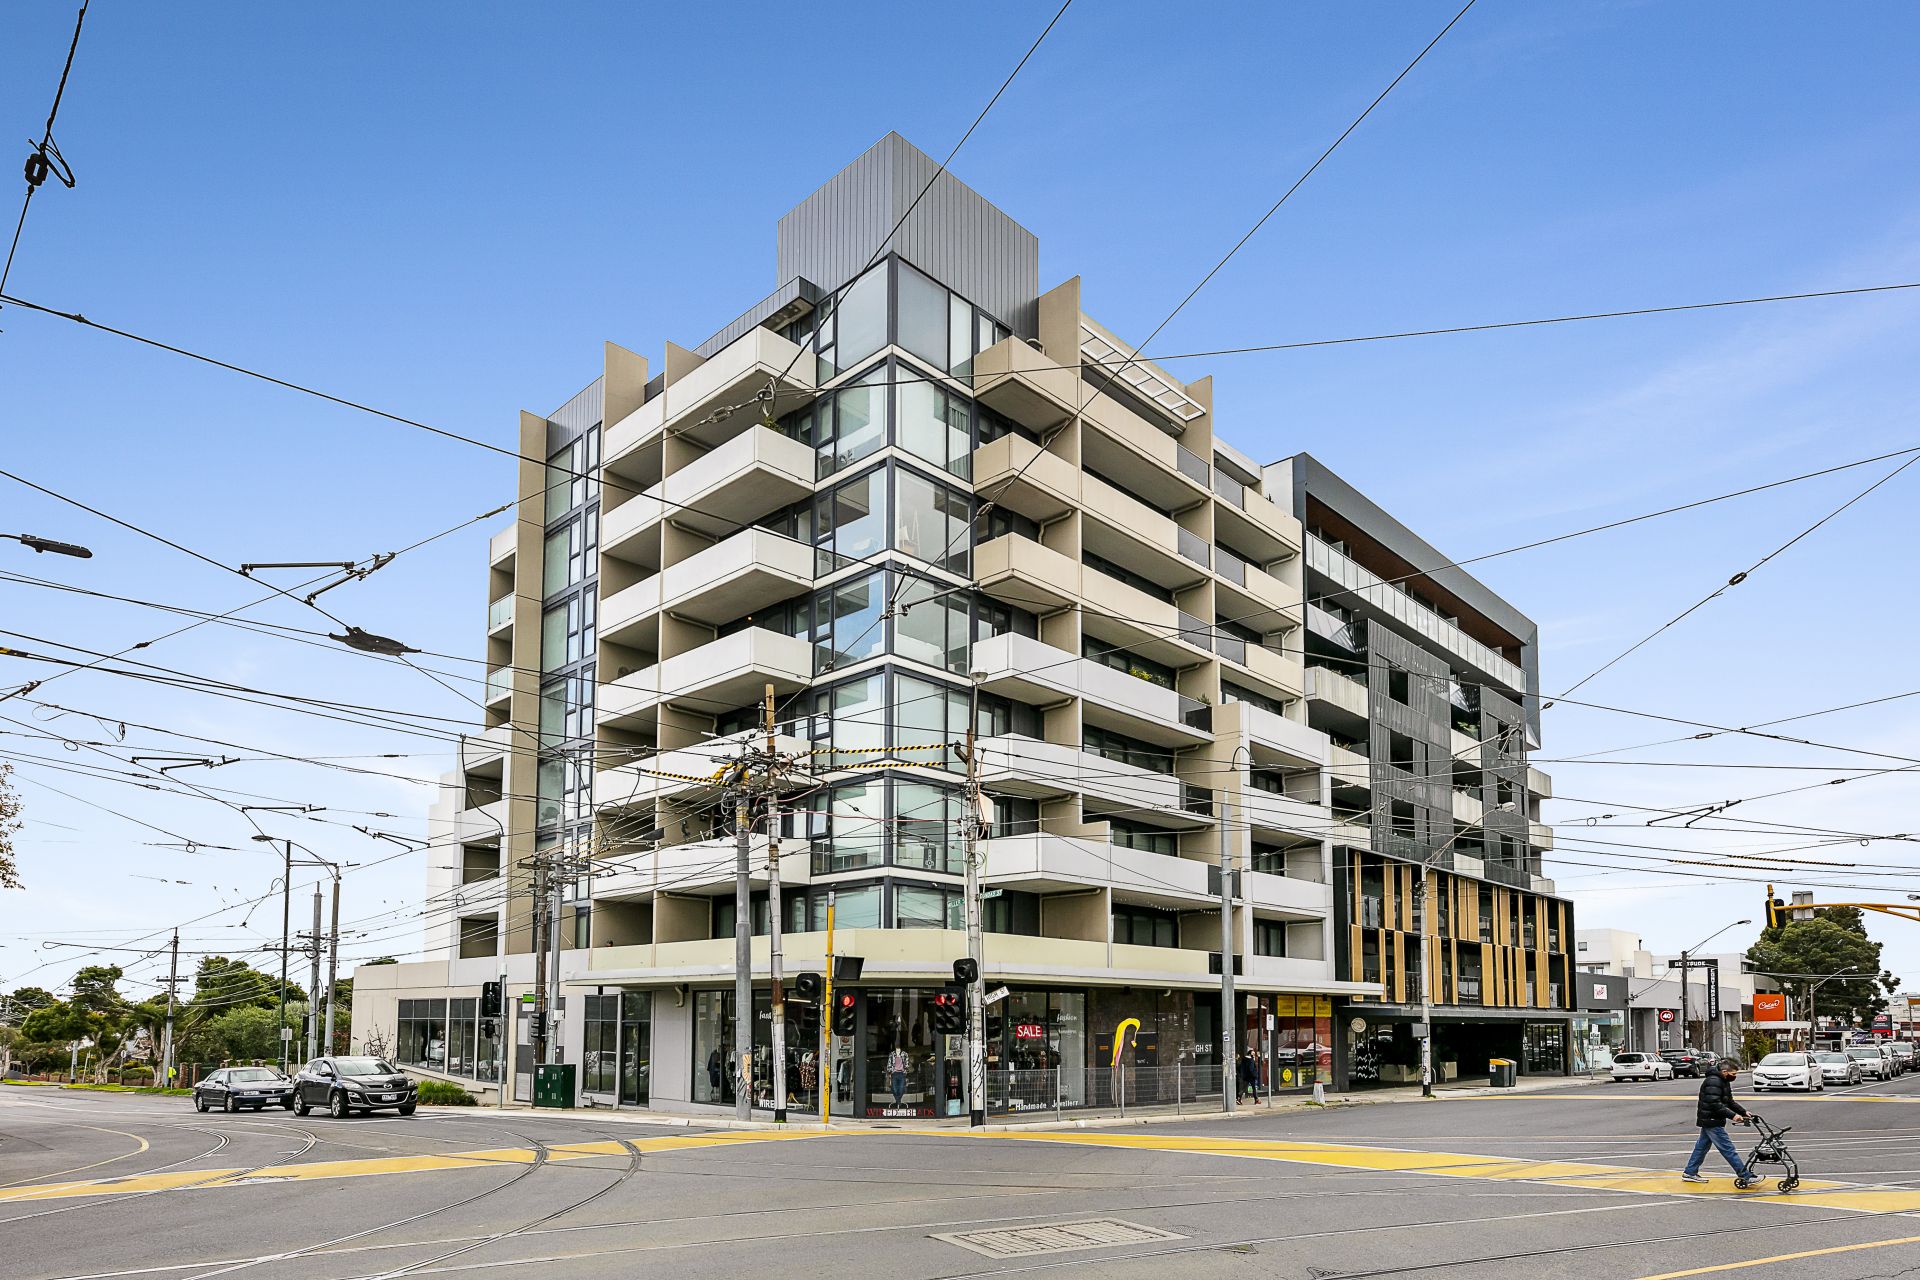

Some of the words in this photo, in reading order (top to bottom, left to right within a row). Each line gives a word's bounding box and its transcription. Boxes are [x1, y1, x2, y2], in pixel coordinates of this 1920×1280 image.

[986, 992, 998, 1000] HIGH
[1056, 1013, 1078, 1023] fashion
[1017, 1025, 1041, 1037] SALE
[1204, 1044, 1213, 1052] ST
[758, 1099, 775, 1108] WIRE
[1015, 1102, 1047, 1111] Handmade
